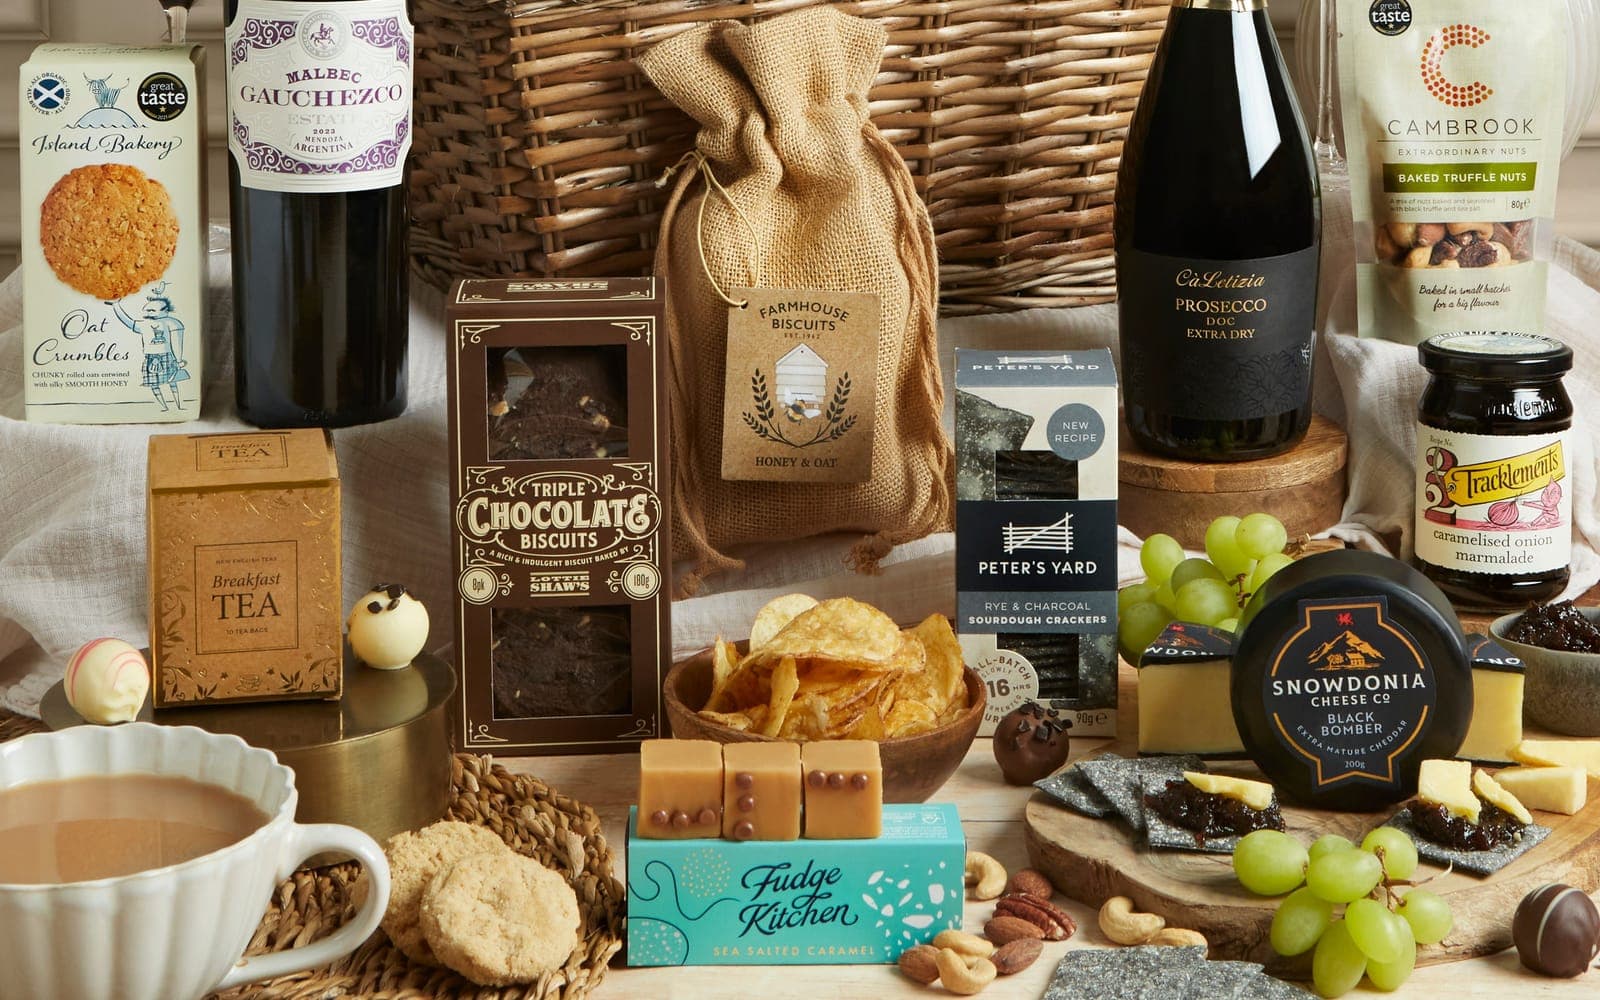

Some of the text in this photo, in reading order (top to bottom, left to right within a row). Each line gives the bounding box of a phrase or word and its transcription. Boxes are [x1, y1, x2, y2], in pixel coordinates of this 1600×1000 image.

[1380, 2, 1401, 11] great
[1371, 10, 1411, 24] taste
[286, 68, 363, 85] MALBEC
[150, 82, 175, 93] great
[140, 91, 186, 106] taste
[240, 84, 403, 107] GAUCHEZCO
[1387, 118, 1534, 136] CAMBROOK
[304, 135, 344, 143] MENDOZA
[32, 133, 183, 160] Island Bakery
[293, 141, 355, 154] ARGENTINA
[1397, 147, 1527, 157] EXTRAORDINARY NUTS
[1398, 172, 1527, 184] BAKED TRUFFLE NUTS
[1418, 284, 1448, 295] Baked
[1448, 286, 1457, 295] in
[1460, 283, 1484, 295] small
[1175, 298, 1268, 313] PROSECCO
[1433, 297, 1447, 312] for
[1456, 297, 1469, 311] big
[1469, 297, 1500, 311] flavour
[759, 301, 850, 323] FARMHOUSE
[61, 308, 110, 340] Oat
[771, 318, 837, 332] BISCUITS
[1206, 316, 1236, 326] DOC
[1187, 328, 1256, 340] EXTRA DRY
[33, 338, 130, 366] Crumbles
[972, 363, 1100, 371] PETER'S YARD
[32, 371, 65, 379] CHUNKY
[66, 371, 85, 379] rolled
[101, 370, 130, 378] entwined
[34, 380, 48, 388] with
[65, 380, 99, 388] SMOOTH
[101, 379, 129, 387] HONEY
[1063, 421, 1089, 430] NEW
[1055, 433, 1097, 443] RECIPE
[210, 448, 271, 459] TEA
[755, 457, 838, 468] HONEY & OAT
[1452, 448, 1559, 500] Tracklements
[532, 482, 586, 498] TRIPLE
[467, 493, 650, 537] CHOCOLATE
[520, 532, 598, 550] BISCUITS
[1433, 529, 1553, 548] caramelised onion
[496, 552, 513, 562] RICH
[521, 558, 562, 567] INDULGENT
[564, 556, 593, 567] BISCUIT
[594, 550, 619, 562] BAKED
[620, 546, 629, 555] BY
[1455, 551, 1534, 564] marmalade
[978, 560, 1098, 575] PETER'S YARD
[211, 571, 282, 591] Breakfast
[530, 575, 590, 583] LOTTIE
[633, 573, 650, 589] 180g
[530, 582, 591, 593] SHAW'S
[211, 591, 282, 620] TEA
[984, 601, 1091, 611] RYE & CHARCOAL
[968, 615, 1107, 625] SOURDOUGH CRACKERS
[986, 678, 1010, 698] 16
[1272, 673, 1426, 697] SNOWDONIA
[1311, 694, 1368, 708] CHEESE
[1327, 711, 1375, 724] BLACK
[1321, 723, 1383, 737] BOMBER
[1296, 719, 1408, 756] EXTRA MATURE CHEDDAR
[1344, 760, 1366, 769] 200g
[740, 859, 843, 907] Fudge
[738, 897, 860, 938] Kitchen
[713, 944, 875, 957] SEA SALTED CARAMEL
